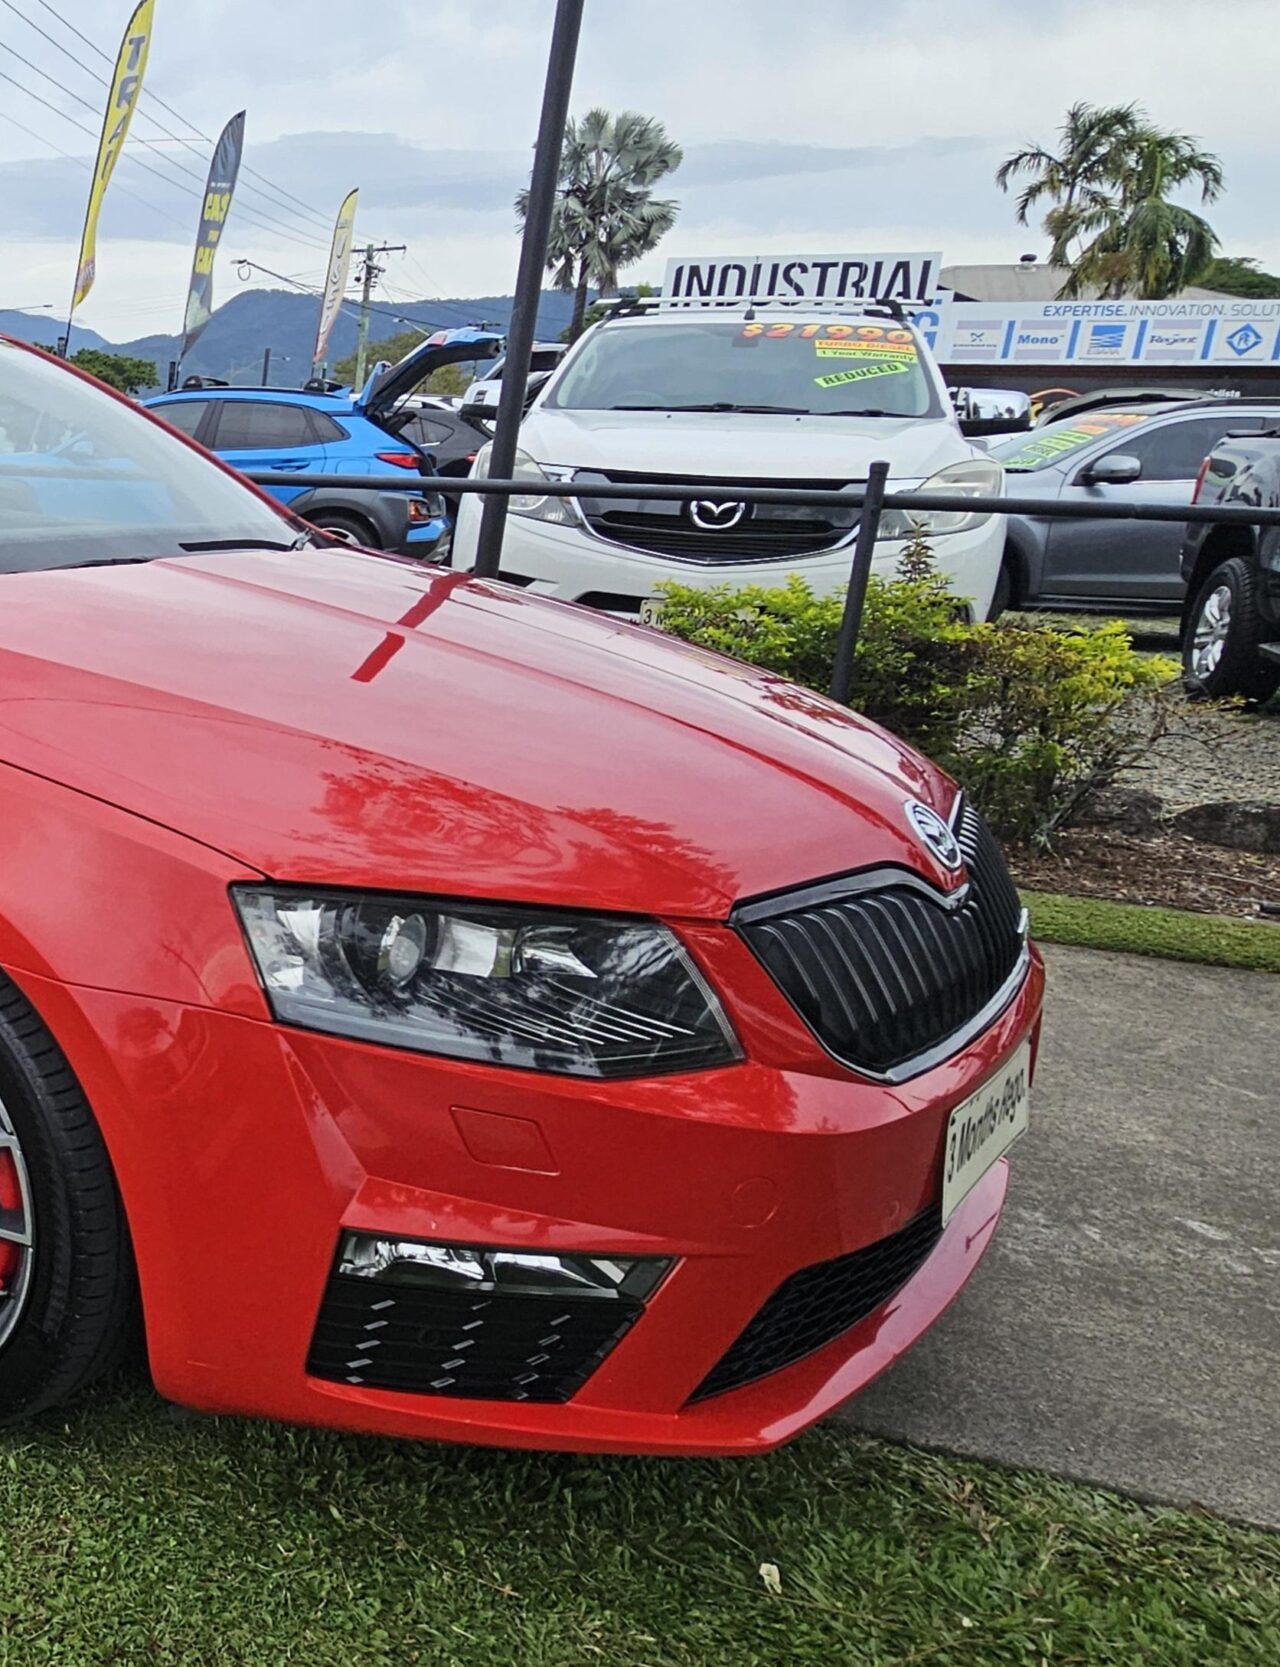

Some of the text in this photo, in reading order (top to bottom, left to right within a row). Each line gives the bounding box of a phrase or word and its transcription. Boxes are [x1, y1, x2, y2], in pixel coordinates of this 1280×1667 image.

[671, 260, 933, 306] INDUSTRIAL
[1043, 305, 1127, 317] EXPERTISE.
[1129, 304, 1226, 316] INNOVATION.
[742, 323, 914, 344] $21990
[1017, 335, 1059, 345] Mono
[861, 351, 915, 362] Warranty
[823, 364, 899, 386] REDUCED
